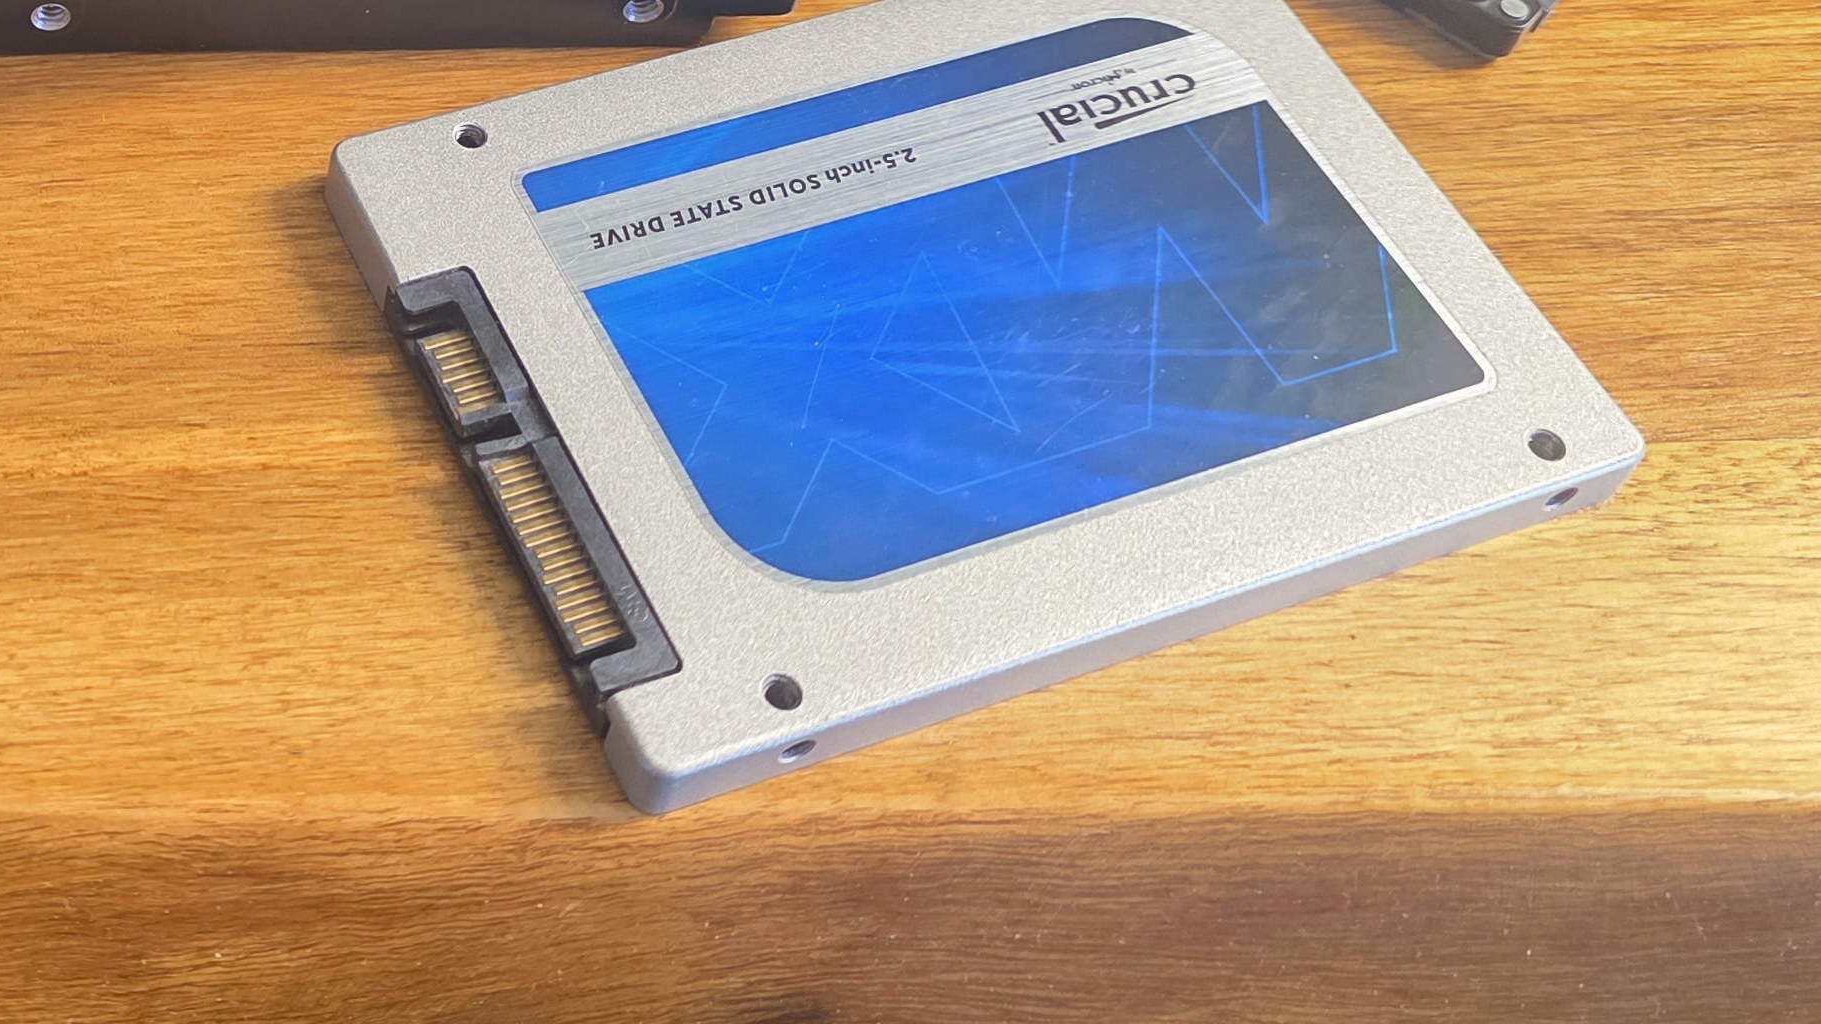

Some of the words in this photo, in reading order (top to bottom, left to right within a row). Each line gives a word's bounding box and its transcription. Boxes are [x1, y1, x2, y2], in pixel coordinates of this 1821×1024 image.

[1037, 74, 1196, 144] crucial
[823, 146, 917, 183] 2.5-inch
[747, 173, 821, 205] SOLID
[668, 194, 743, 228] STATE
[588, 214, 665, 250] DRIVE
